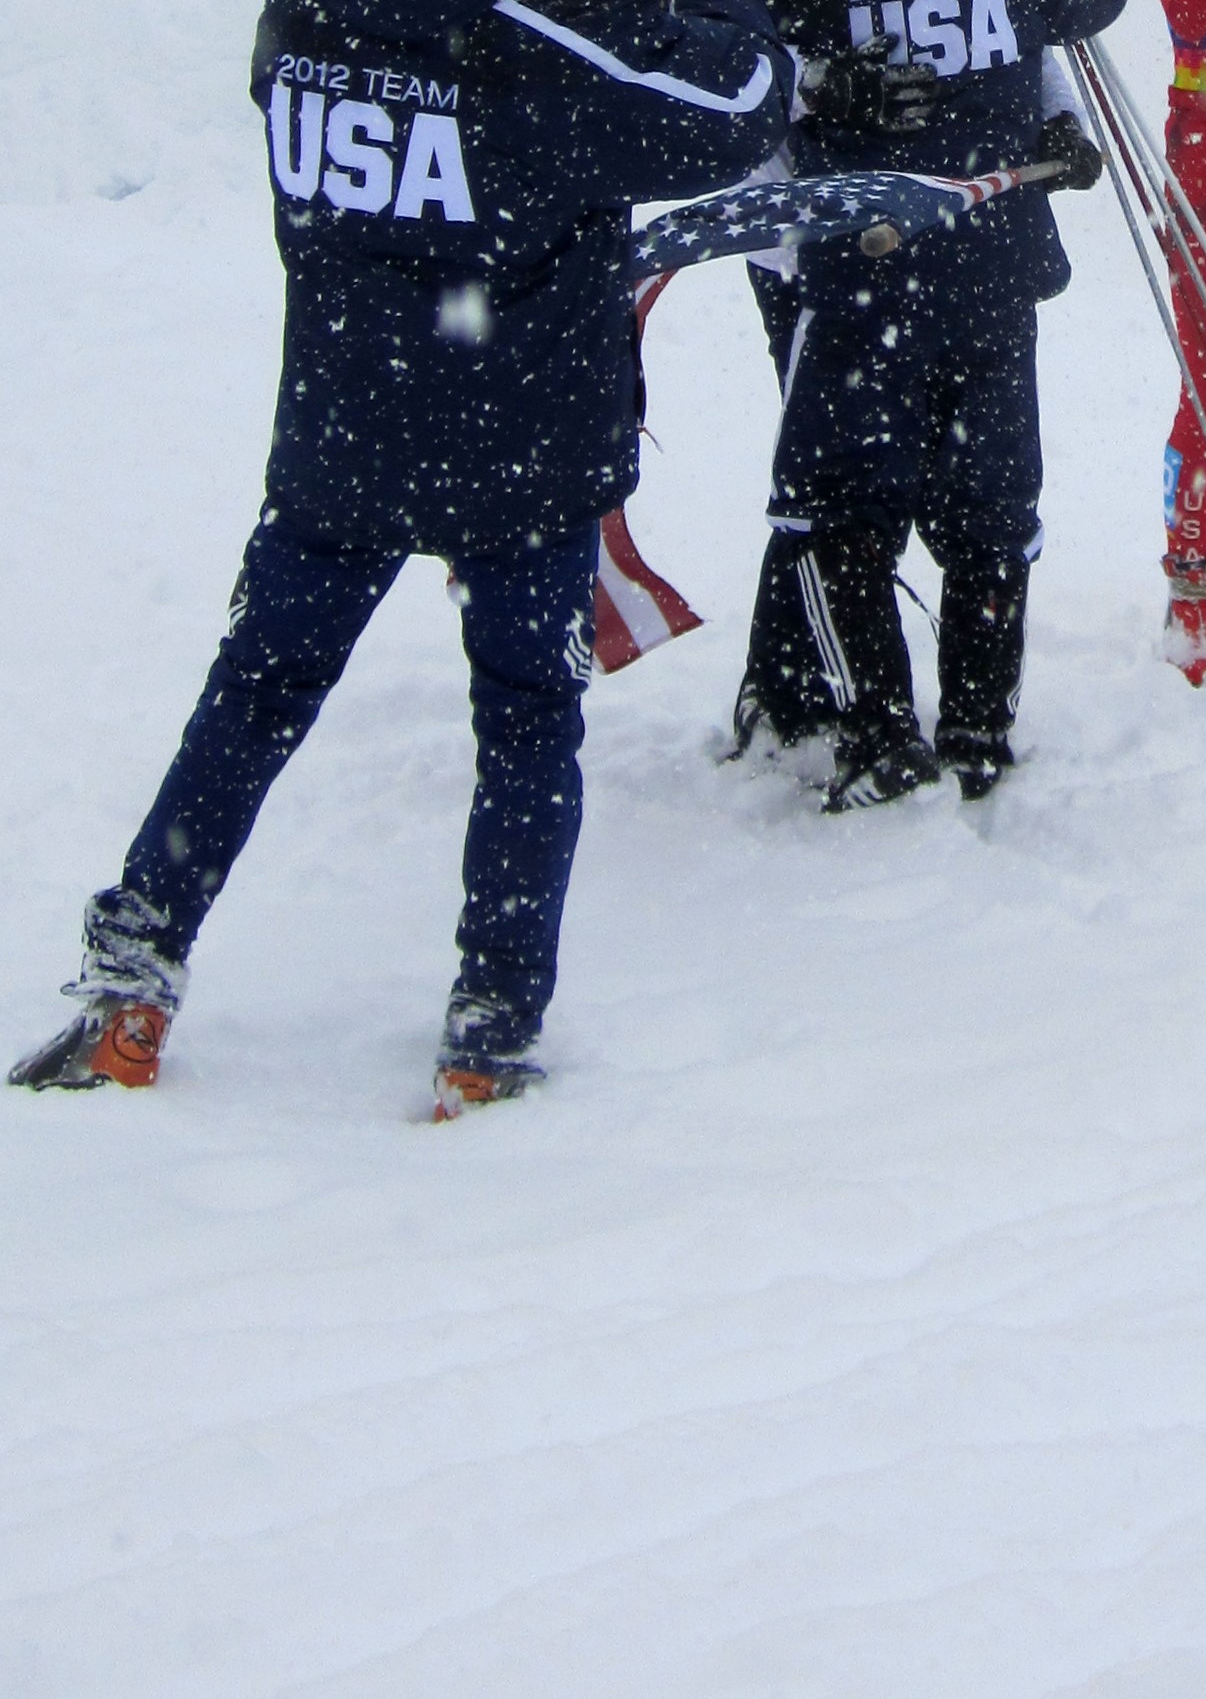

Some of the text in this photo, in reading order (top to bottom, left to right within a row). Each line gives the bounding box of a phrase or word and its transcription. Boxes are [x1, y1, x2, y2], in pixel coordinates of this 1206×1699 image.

[277, 53, 460, 110] 2012 TEAM
[270, 83, 477, 223] USA
